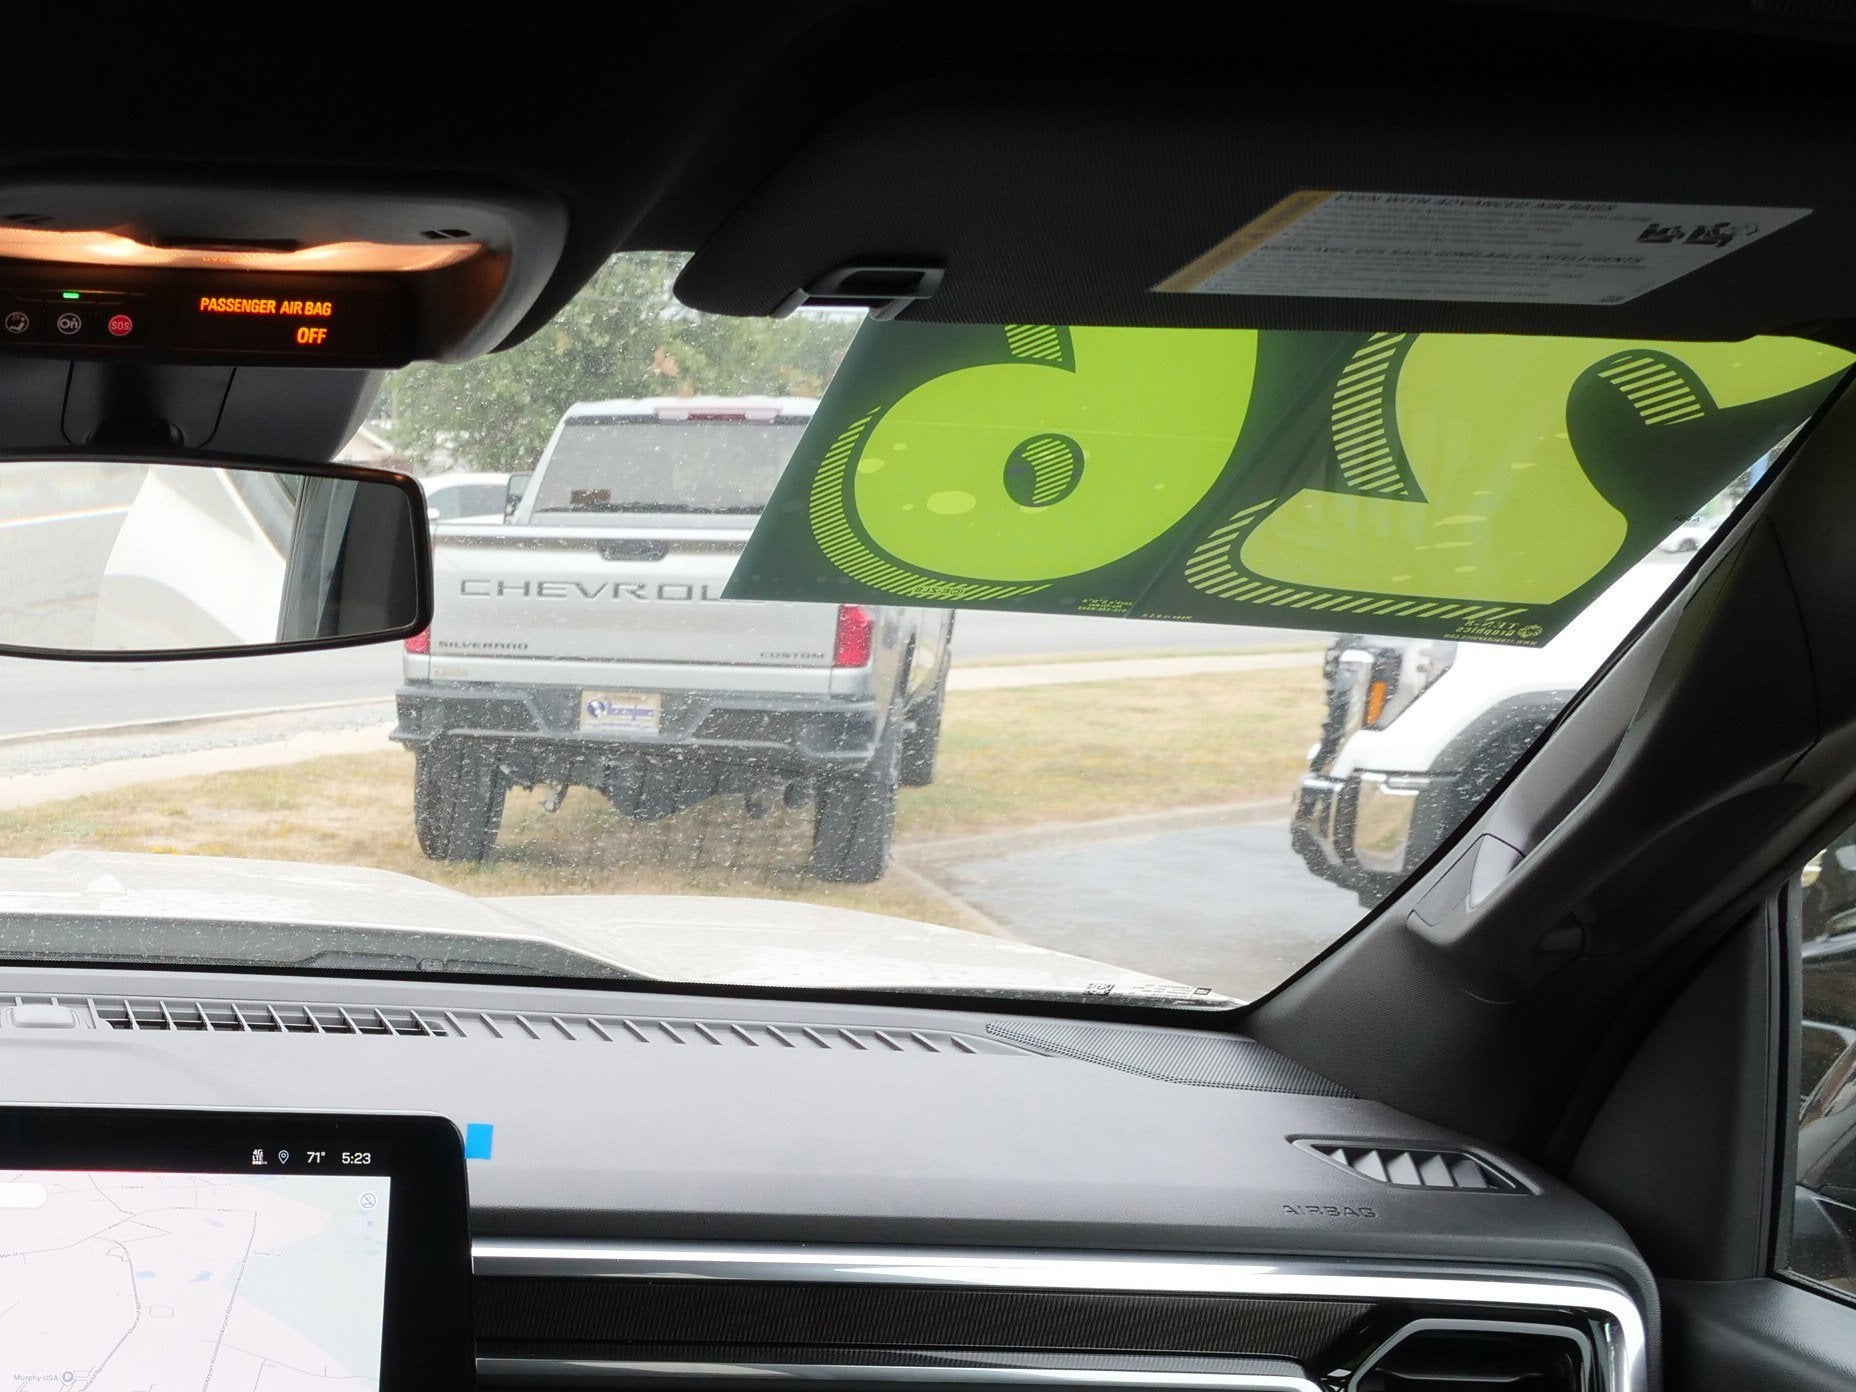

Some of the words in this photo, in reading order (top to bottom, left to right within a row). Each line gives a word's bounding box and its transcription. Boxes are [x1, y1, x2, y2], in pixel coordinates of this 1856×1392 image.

[200, 297, 276, 314] PASSENGER
[280, 300, 302, 315] AIR
[304, 301, 332, 316] BAG
[111, 321, 129, 331] SOS
[297, 327, 328, 344] OFF
[438, 641, 528, 650] SILVERADO
[759, 651, 826, 659] CUSTOM
[252, 1148, 263, 1156] 4G
[306, 1151, 326, 1163] 71°
[341, 1152, 371, 1165] 5:23
[1282, 1204, 1376, 1218] AIRBAG
[13, 1374, 41, 1383] Murphy
